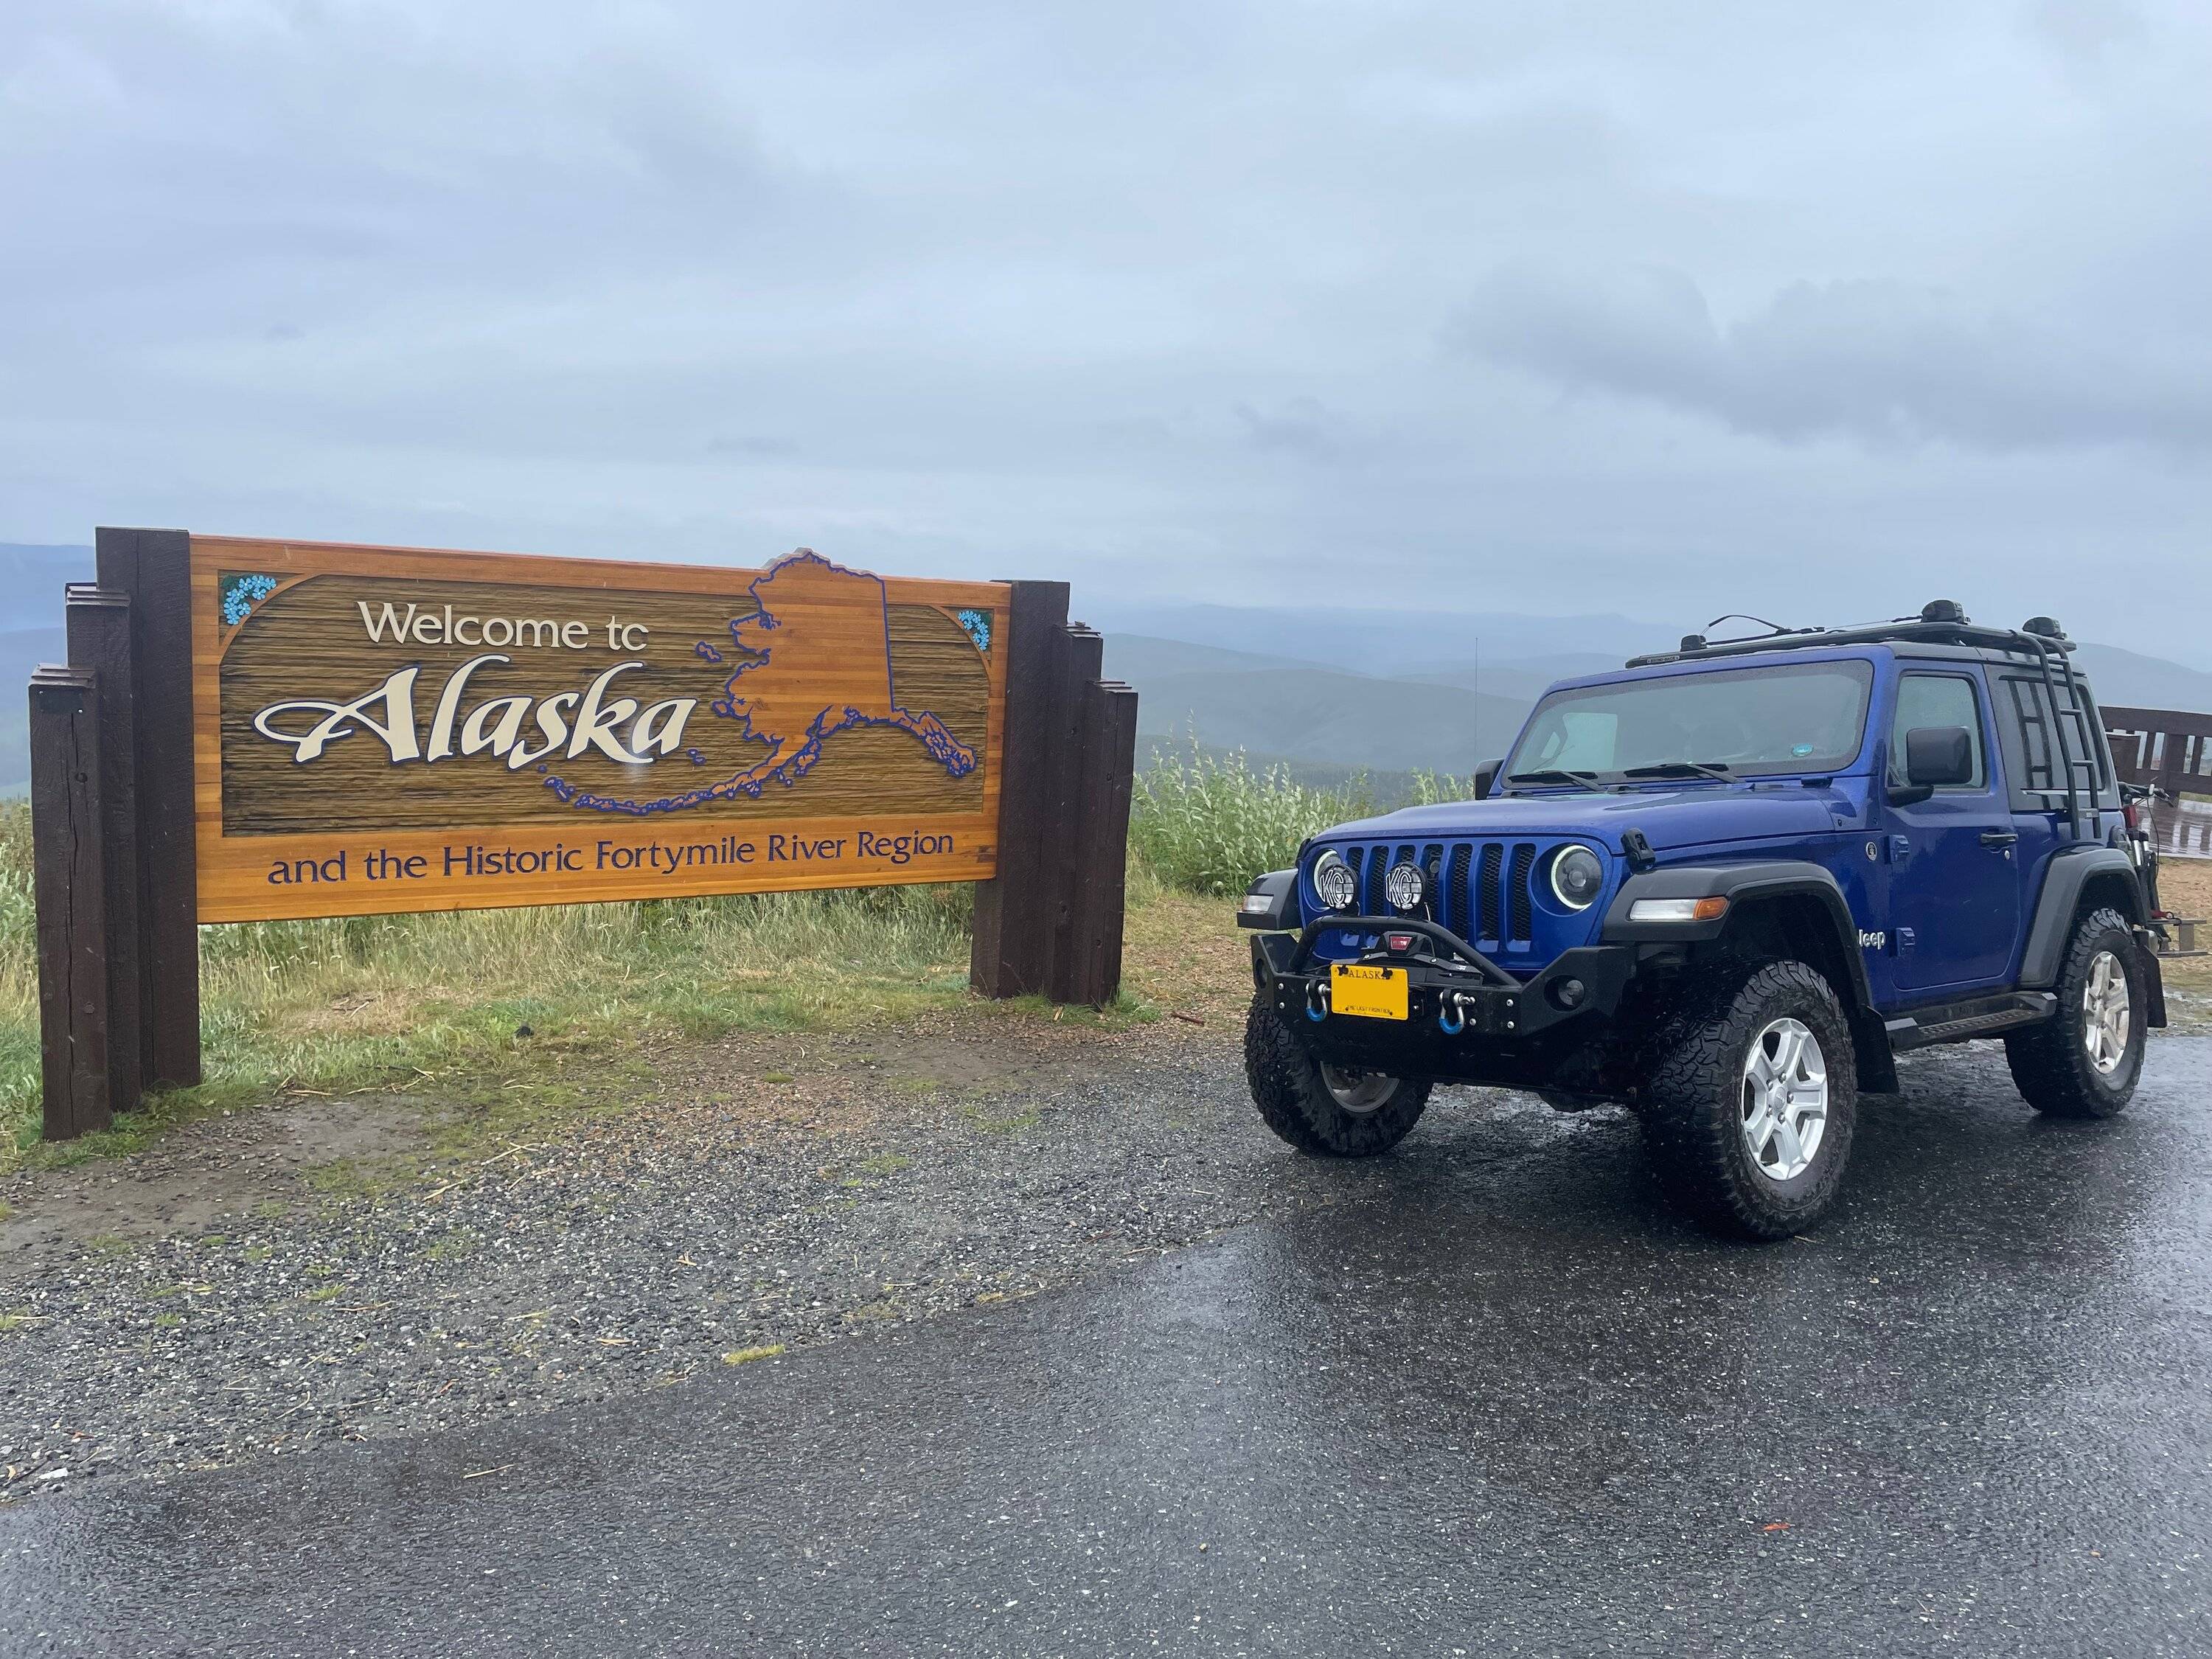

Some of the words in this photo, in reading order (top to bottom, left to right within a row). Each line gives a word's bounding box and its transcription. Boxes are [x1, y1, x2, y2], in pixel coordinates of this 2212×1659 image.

[357, 601, 589, 649] Welcome
[253, 654, 698, 770] Alaska
[267, 850, 347, 884] and
[364, 849, 427, 880] the
[443, 844, 583, 876] Historic
[596, 836, 755, 874] Fortymile
[768, 835, 846, 861] River
[858, 830, 953, 864] Region
[1319, 869, 1345, 908] KC
[1385, 868, 1413, 908] KC
[1349, 969, 1391, 980] ALASK
